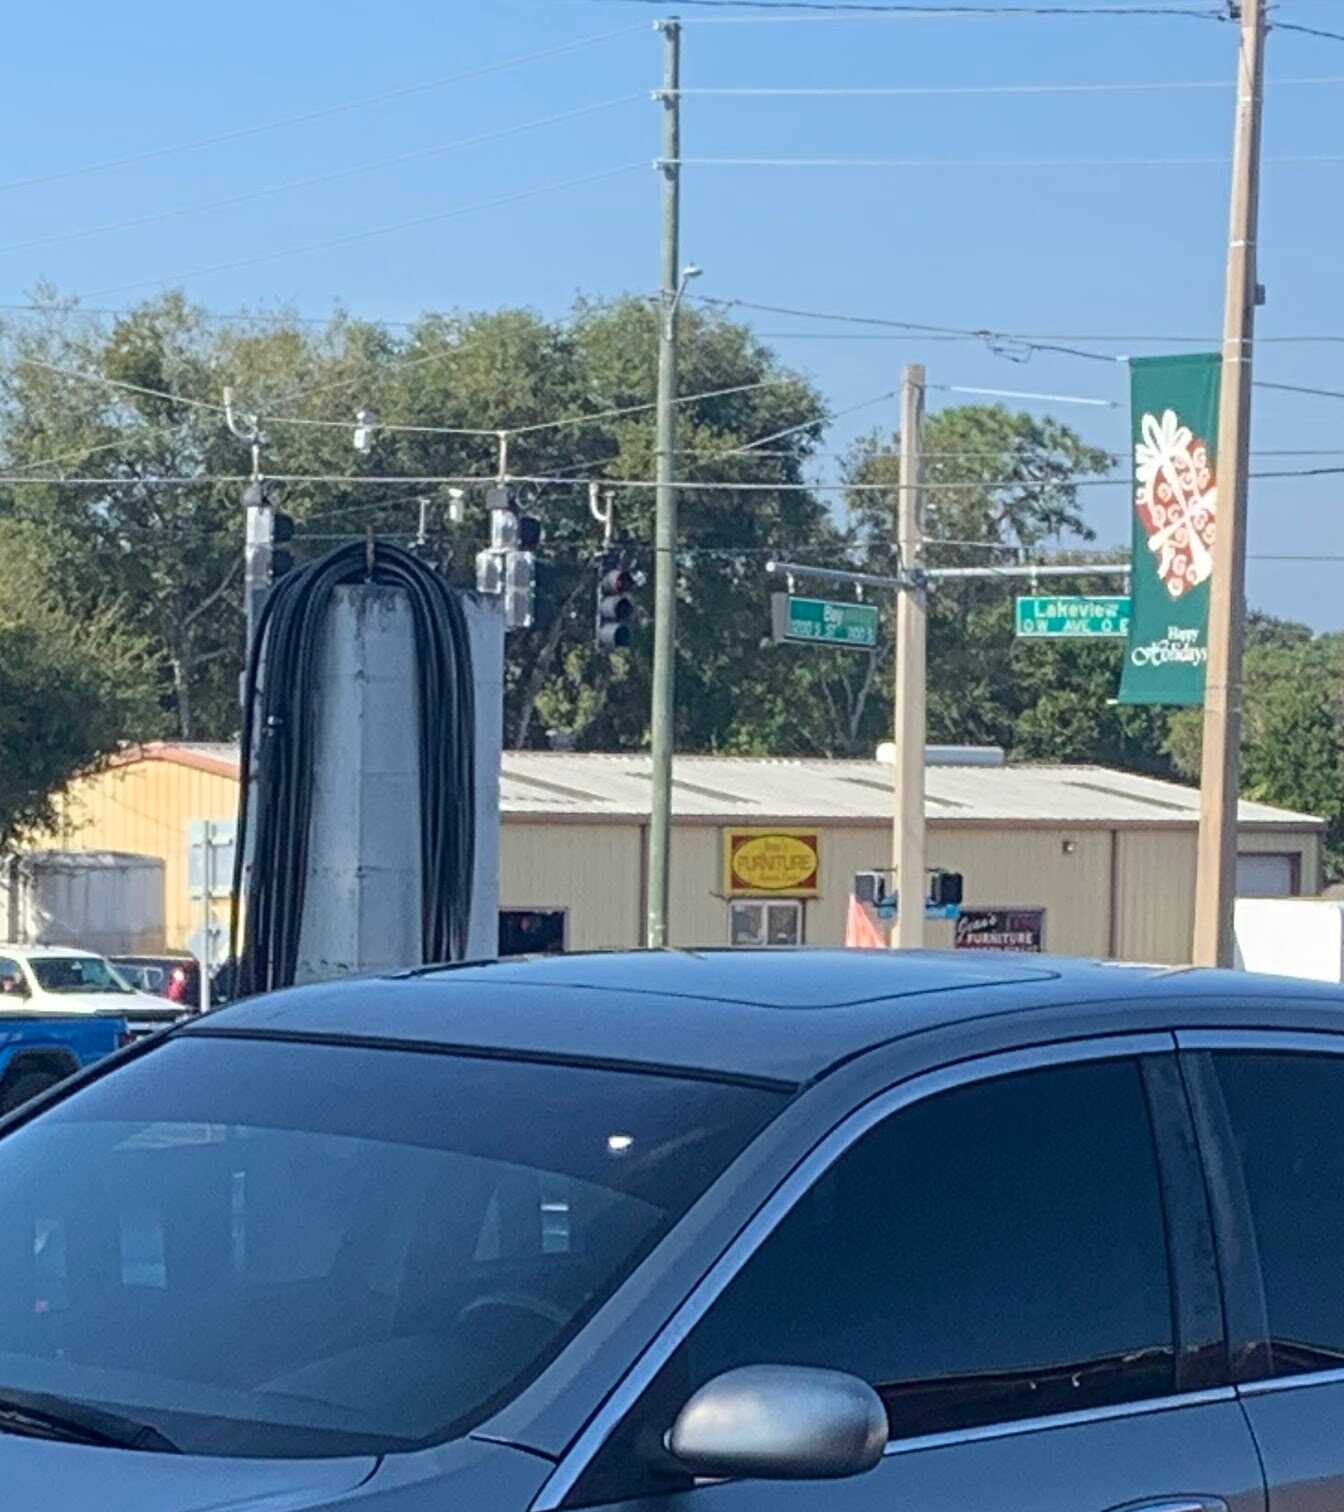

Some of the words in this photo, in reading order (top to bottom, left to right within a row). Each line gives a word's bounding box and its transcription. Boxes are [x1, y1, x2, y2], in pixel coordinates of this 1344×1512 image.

[1034, 601, 1120, 617] Lakeview
[1168, 626, 1200, 643] Happy
[1131, 639, 1208, 667] Holidays
[967, 932, 1033, 945] FURNITURE
